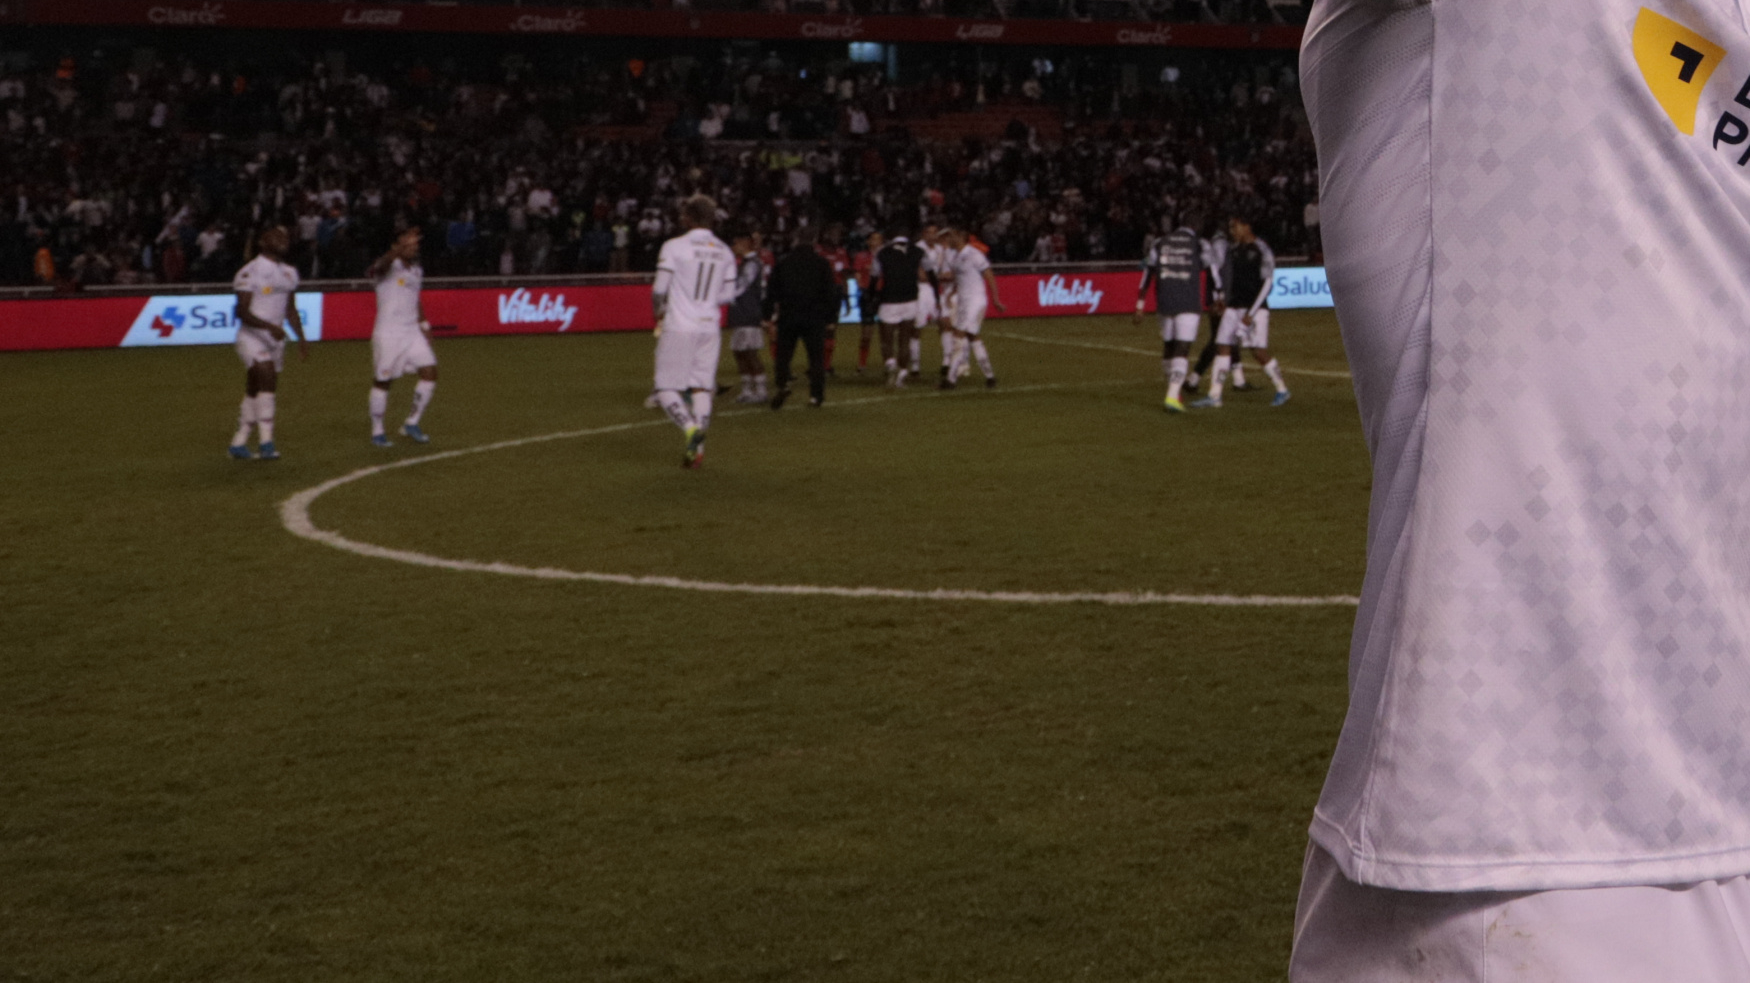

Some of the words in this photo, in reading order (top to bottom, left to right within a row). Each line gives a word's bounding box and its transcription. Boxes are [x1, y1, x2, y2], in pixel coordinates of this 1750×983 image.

[146, 6, 217, 26] Claro
[516, 14, 578, 32] Claro
[800, 20, 856, 38] Claro
[1116, 28, 1171, 44] Claro
[1037, 273, 1105, 314] Vitality
[498, 286, 579, 332] Vitality
